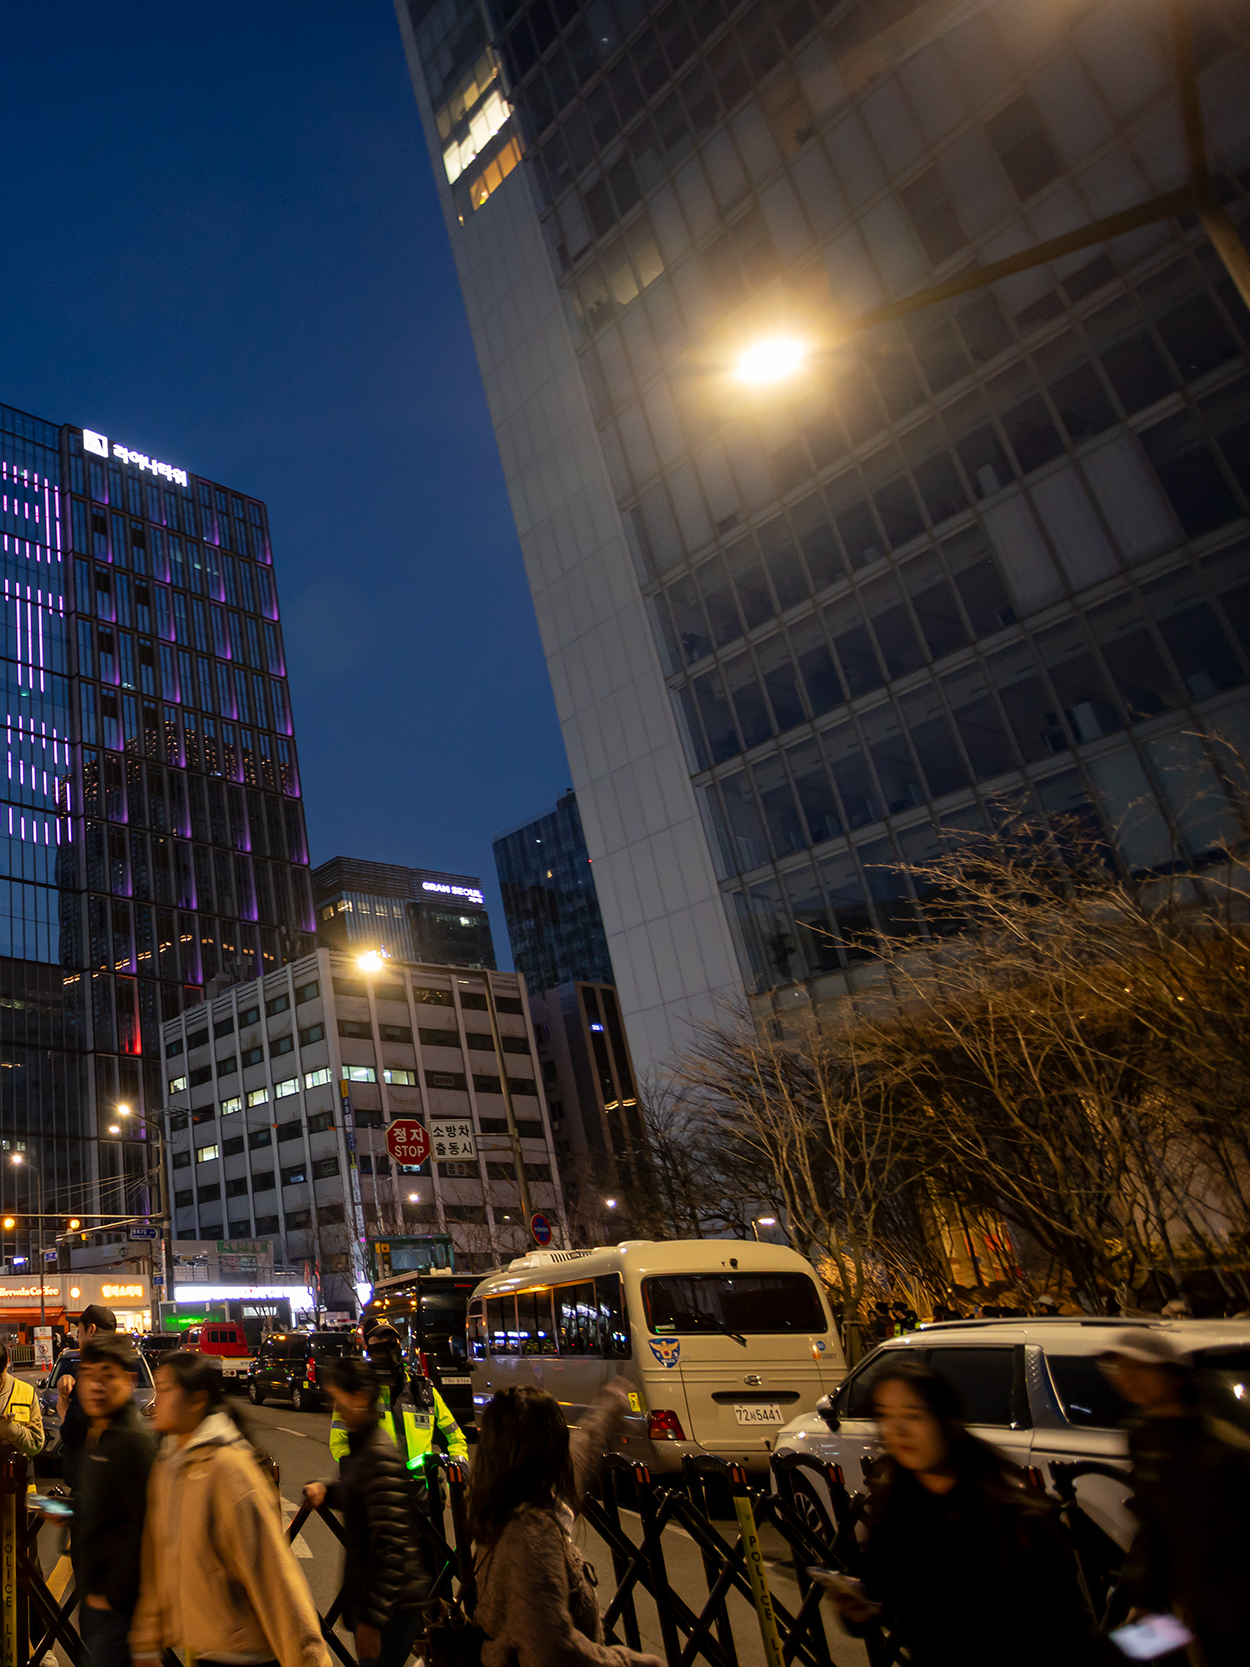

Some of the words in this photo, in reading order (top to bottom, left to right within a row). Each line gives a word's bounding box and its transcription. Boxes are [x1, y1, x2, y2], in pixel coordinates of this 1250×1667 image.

[112, 443, 187, 487] 라이나타워
[421, 882, 451, 893] GRAN
[451, 886, 484, 898] SEOUL
[393, 1127, 424, 1143] 정지
[433, 1124, 470, 1139] 소방차
[394, 1145, 425, 1158] STOP
[436, 1141, 473, 1156] 출동시
